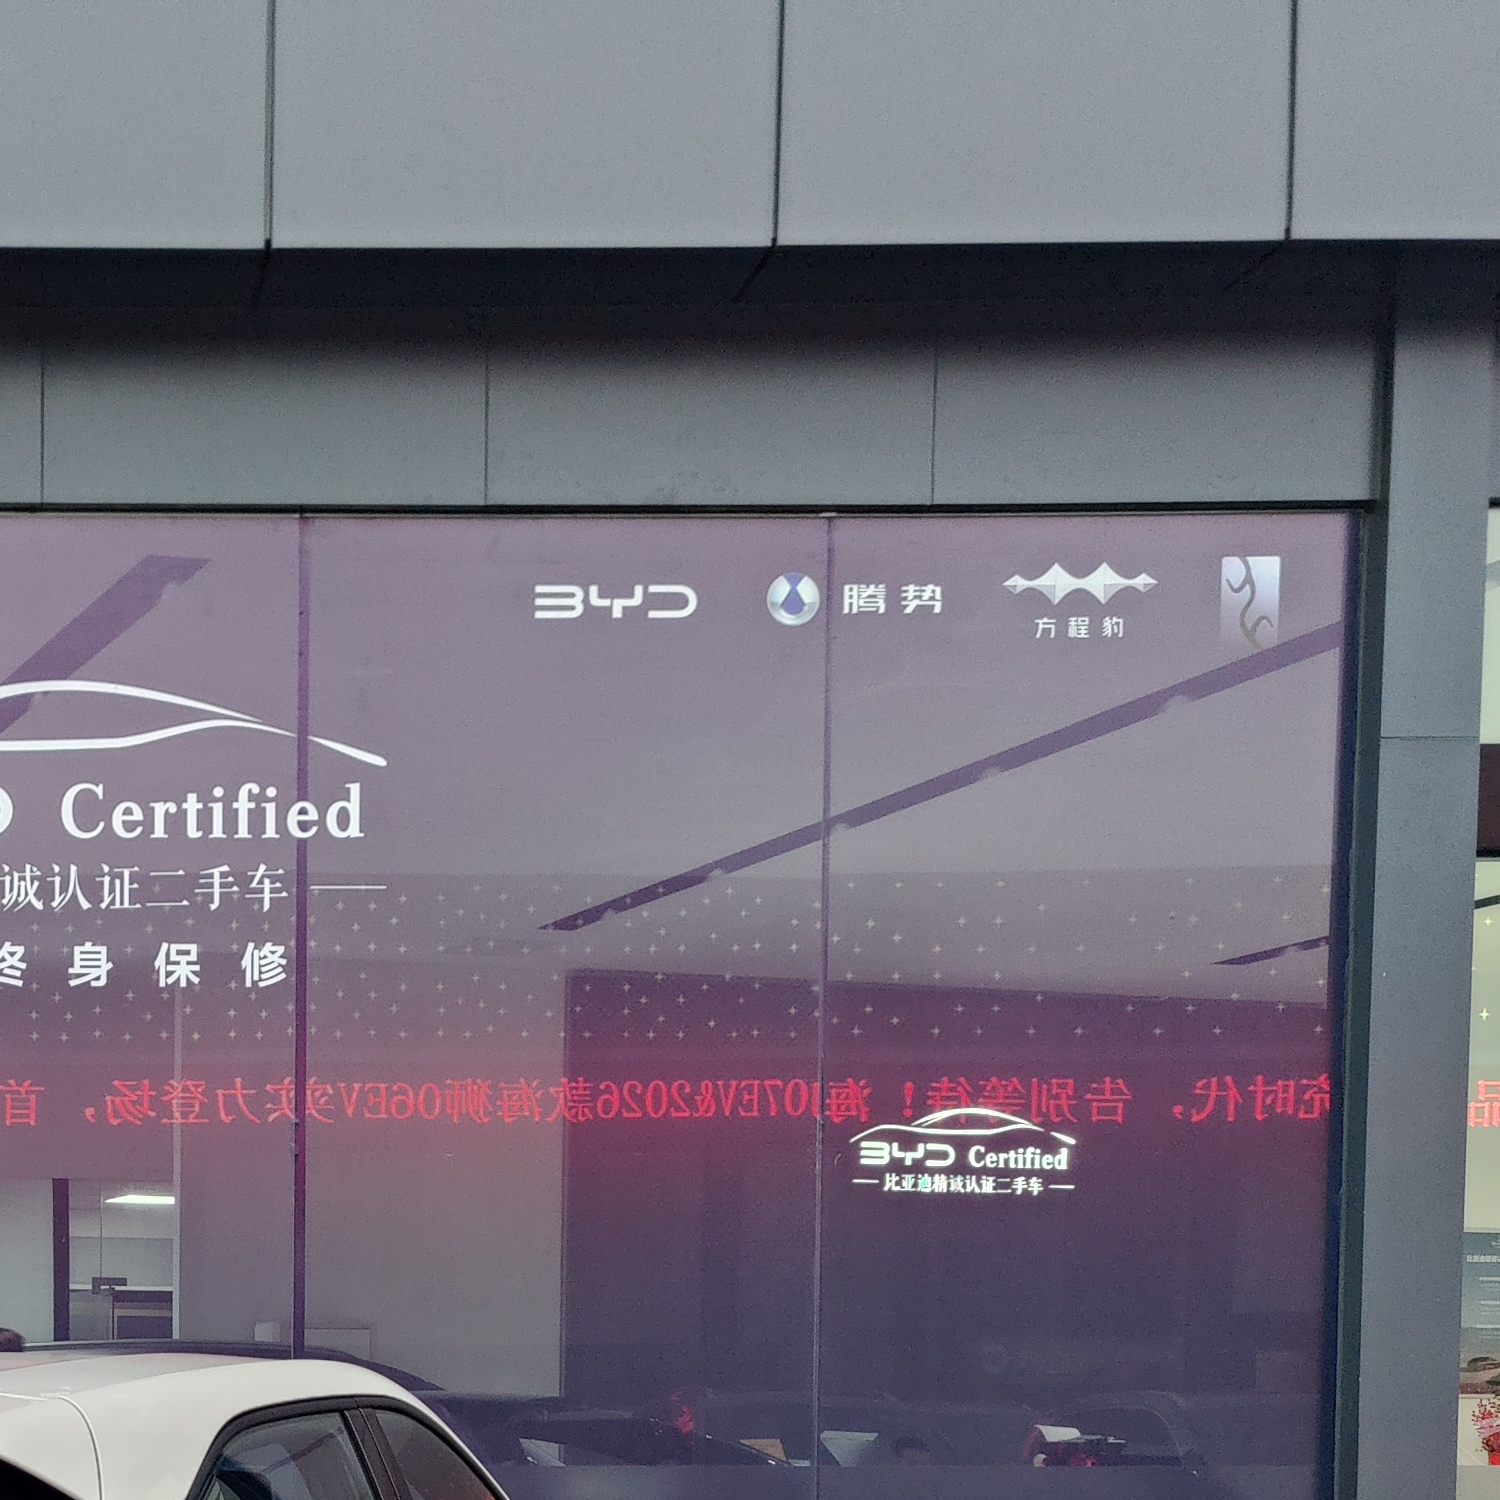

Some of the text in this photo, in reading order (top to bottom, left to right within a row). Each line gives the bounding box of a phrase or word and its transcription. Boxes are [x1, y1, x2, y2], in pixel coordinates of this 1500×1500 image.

[534, 584, 699, 619] BYD
[842, 583, 943, 616] 腾势
[1034, 616, 1125, 639] 方程豹
[60, 782, 365, 840] Certified
[860, 1141, 1068, 1170] BYD Certified
[883, 1173, 1044, 1195] 比亚迪精诚认证二手车
